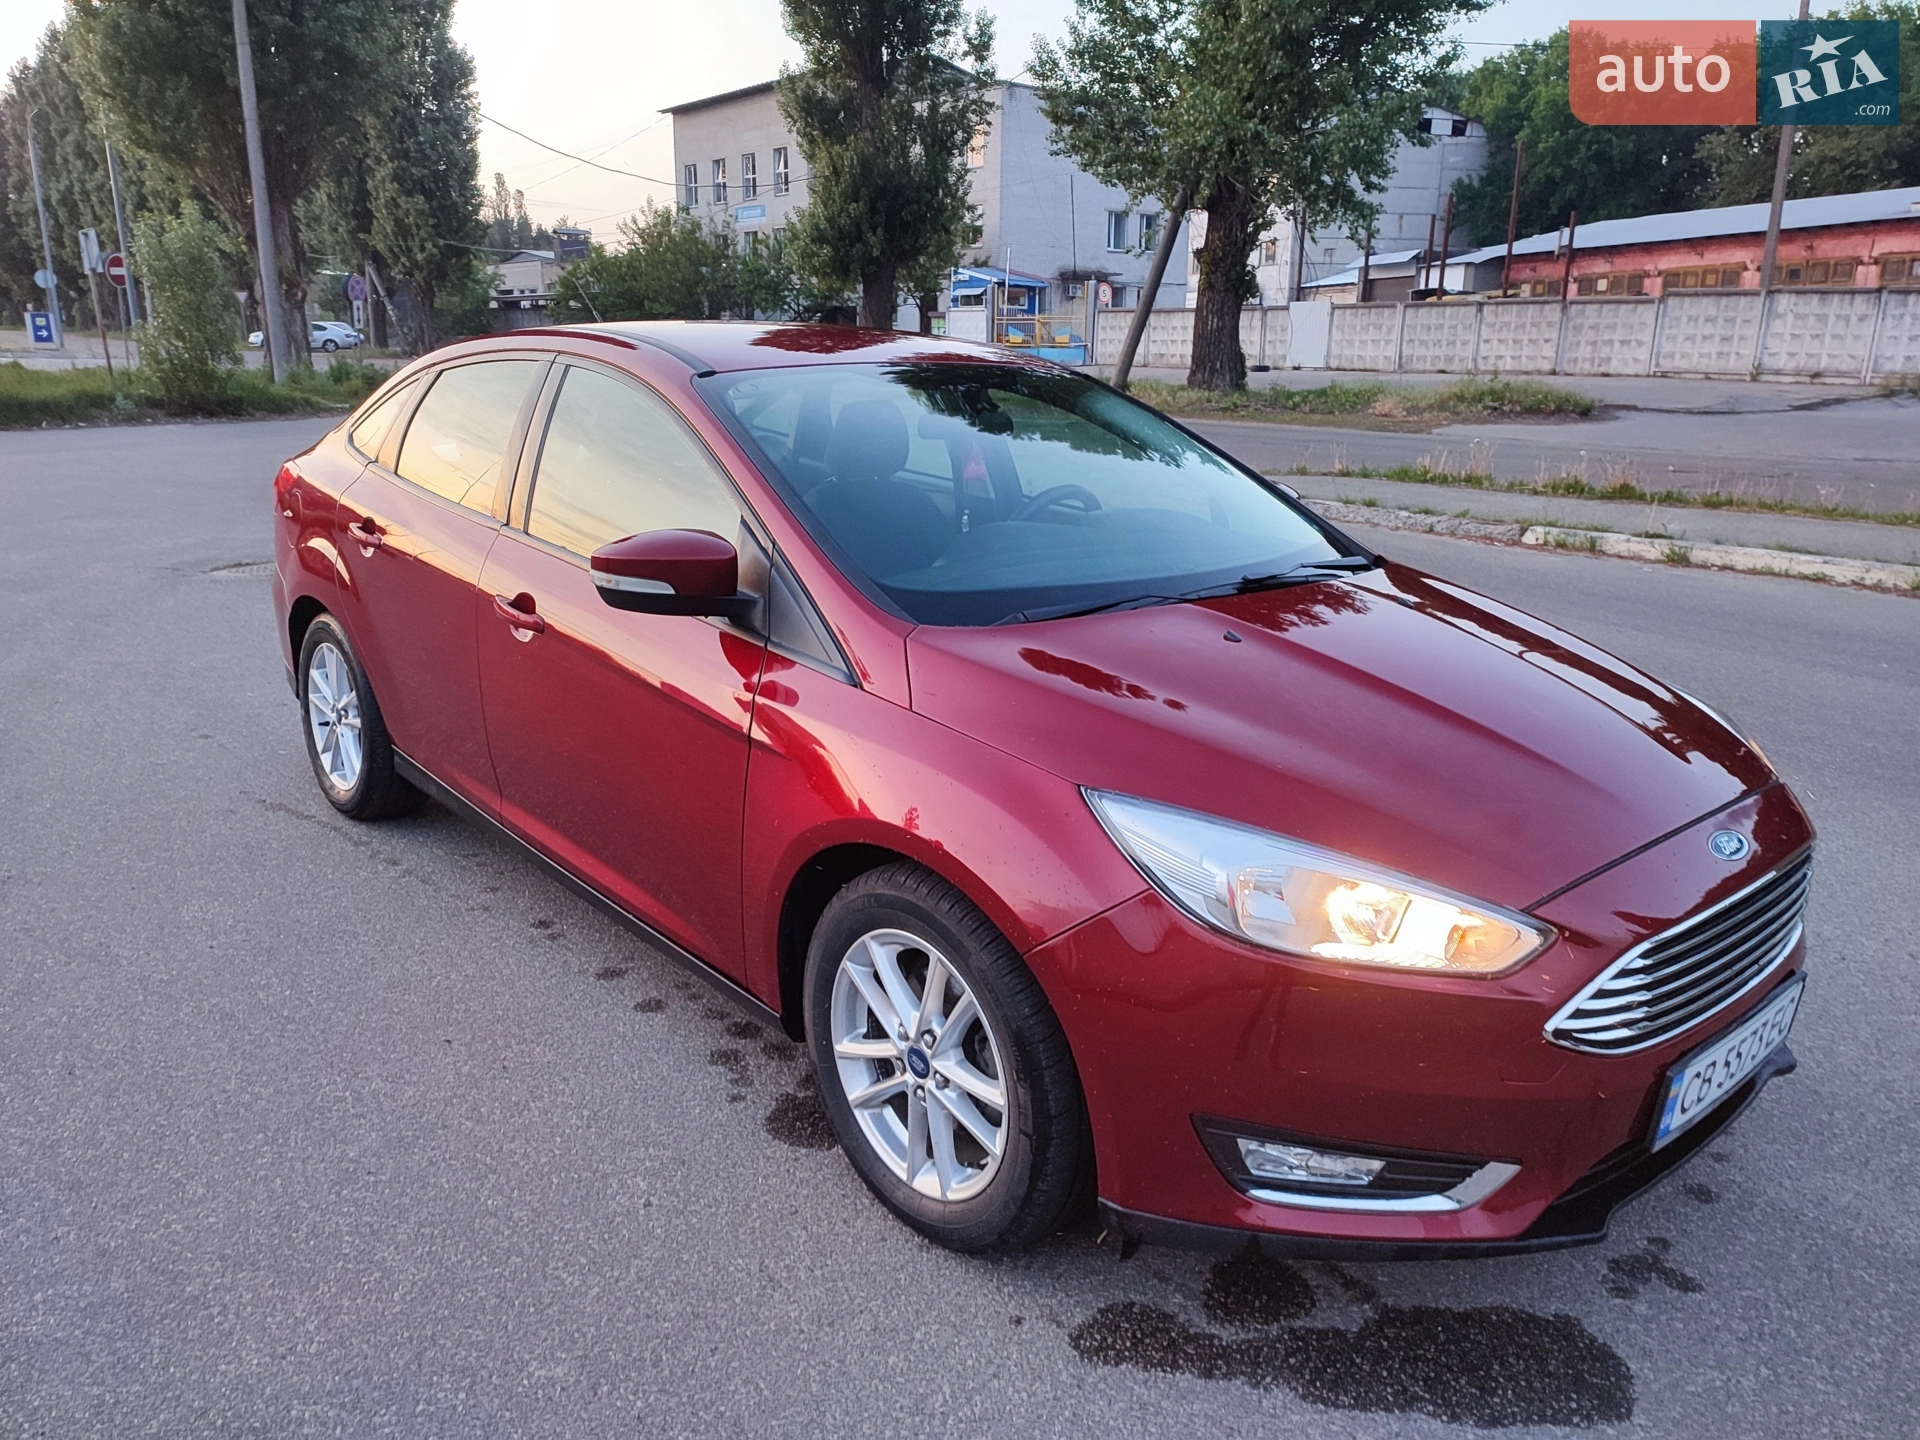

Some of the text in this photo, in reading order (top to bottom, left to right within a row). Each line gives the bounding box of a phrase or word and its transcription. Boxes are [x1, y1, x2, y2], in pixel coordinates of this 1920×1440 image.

[1102, 289, 1107, 298] 5
[1716, 835, 1742, 855] Ford
[1680, 996, 1796, 1115] CB 5573 EC
